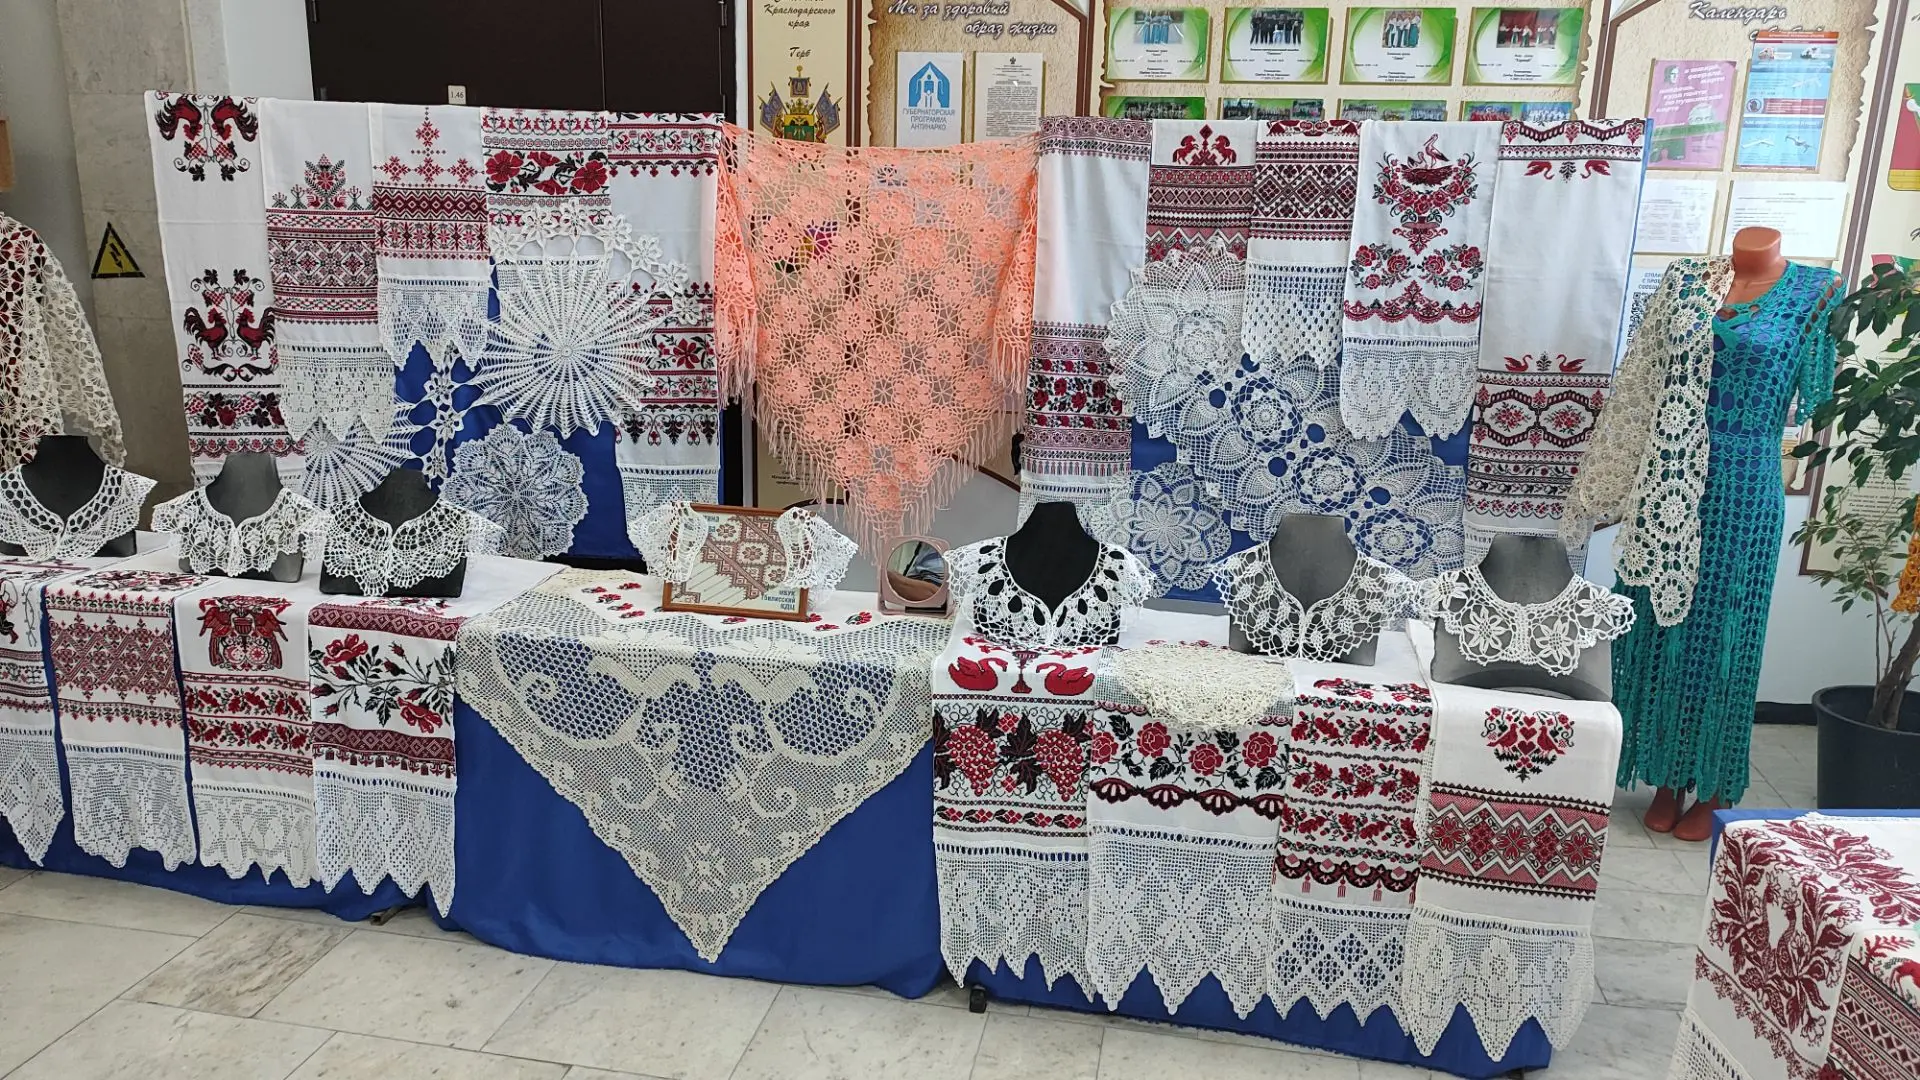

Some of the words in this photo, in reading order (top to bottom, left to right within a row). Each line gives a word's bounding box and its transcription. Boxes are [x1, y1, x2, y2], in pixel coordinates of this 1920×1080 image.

[763, 3, 836, 17] Краснодарского
[888, 0, 917, 15] Мы
[921, 3, 938, 19] за
[943, 0, 1010, 20] здоровый
[1689, 1, 1788, 25] Календарь
[965, 20, 1004, 39] образ
[1009, 22, 1057, 40] жизни
[789, 46, 811, 60] Герб
